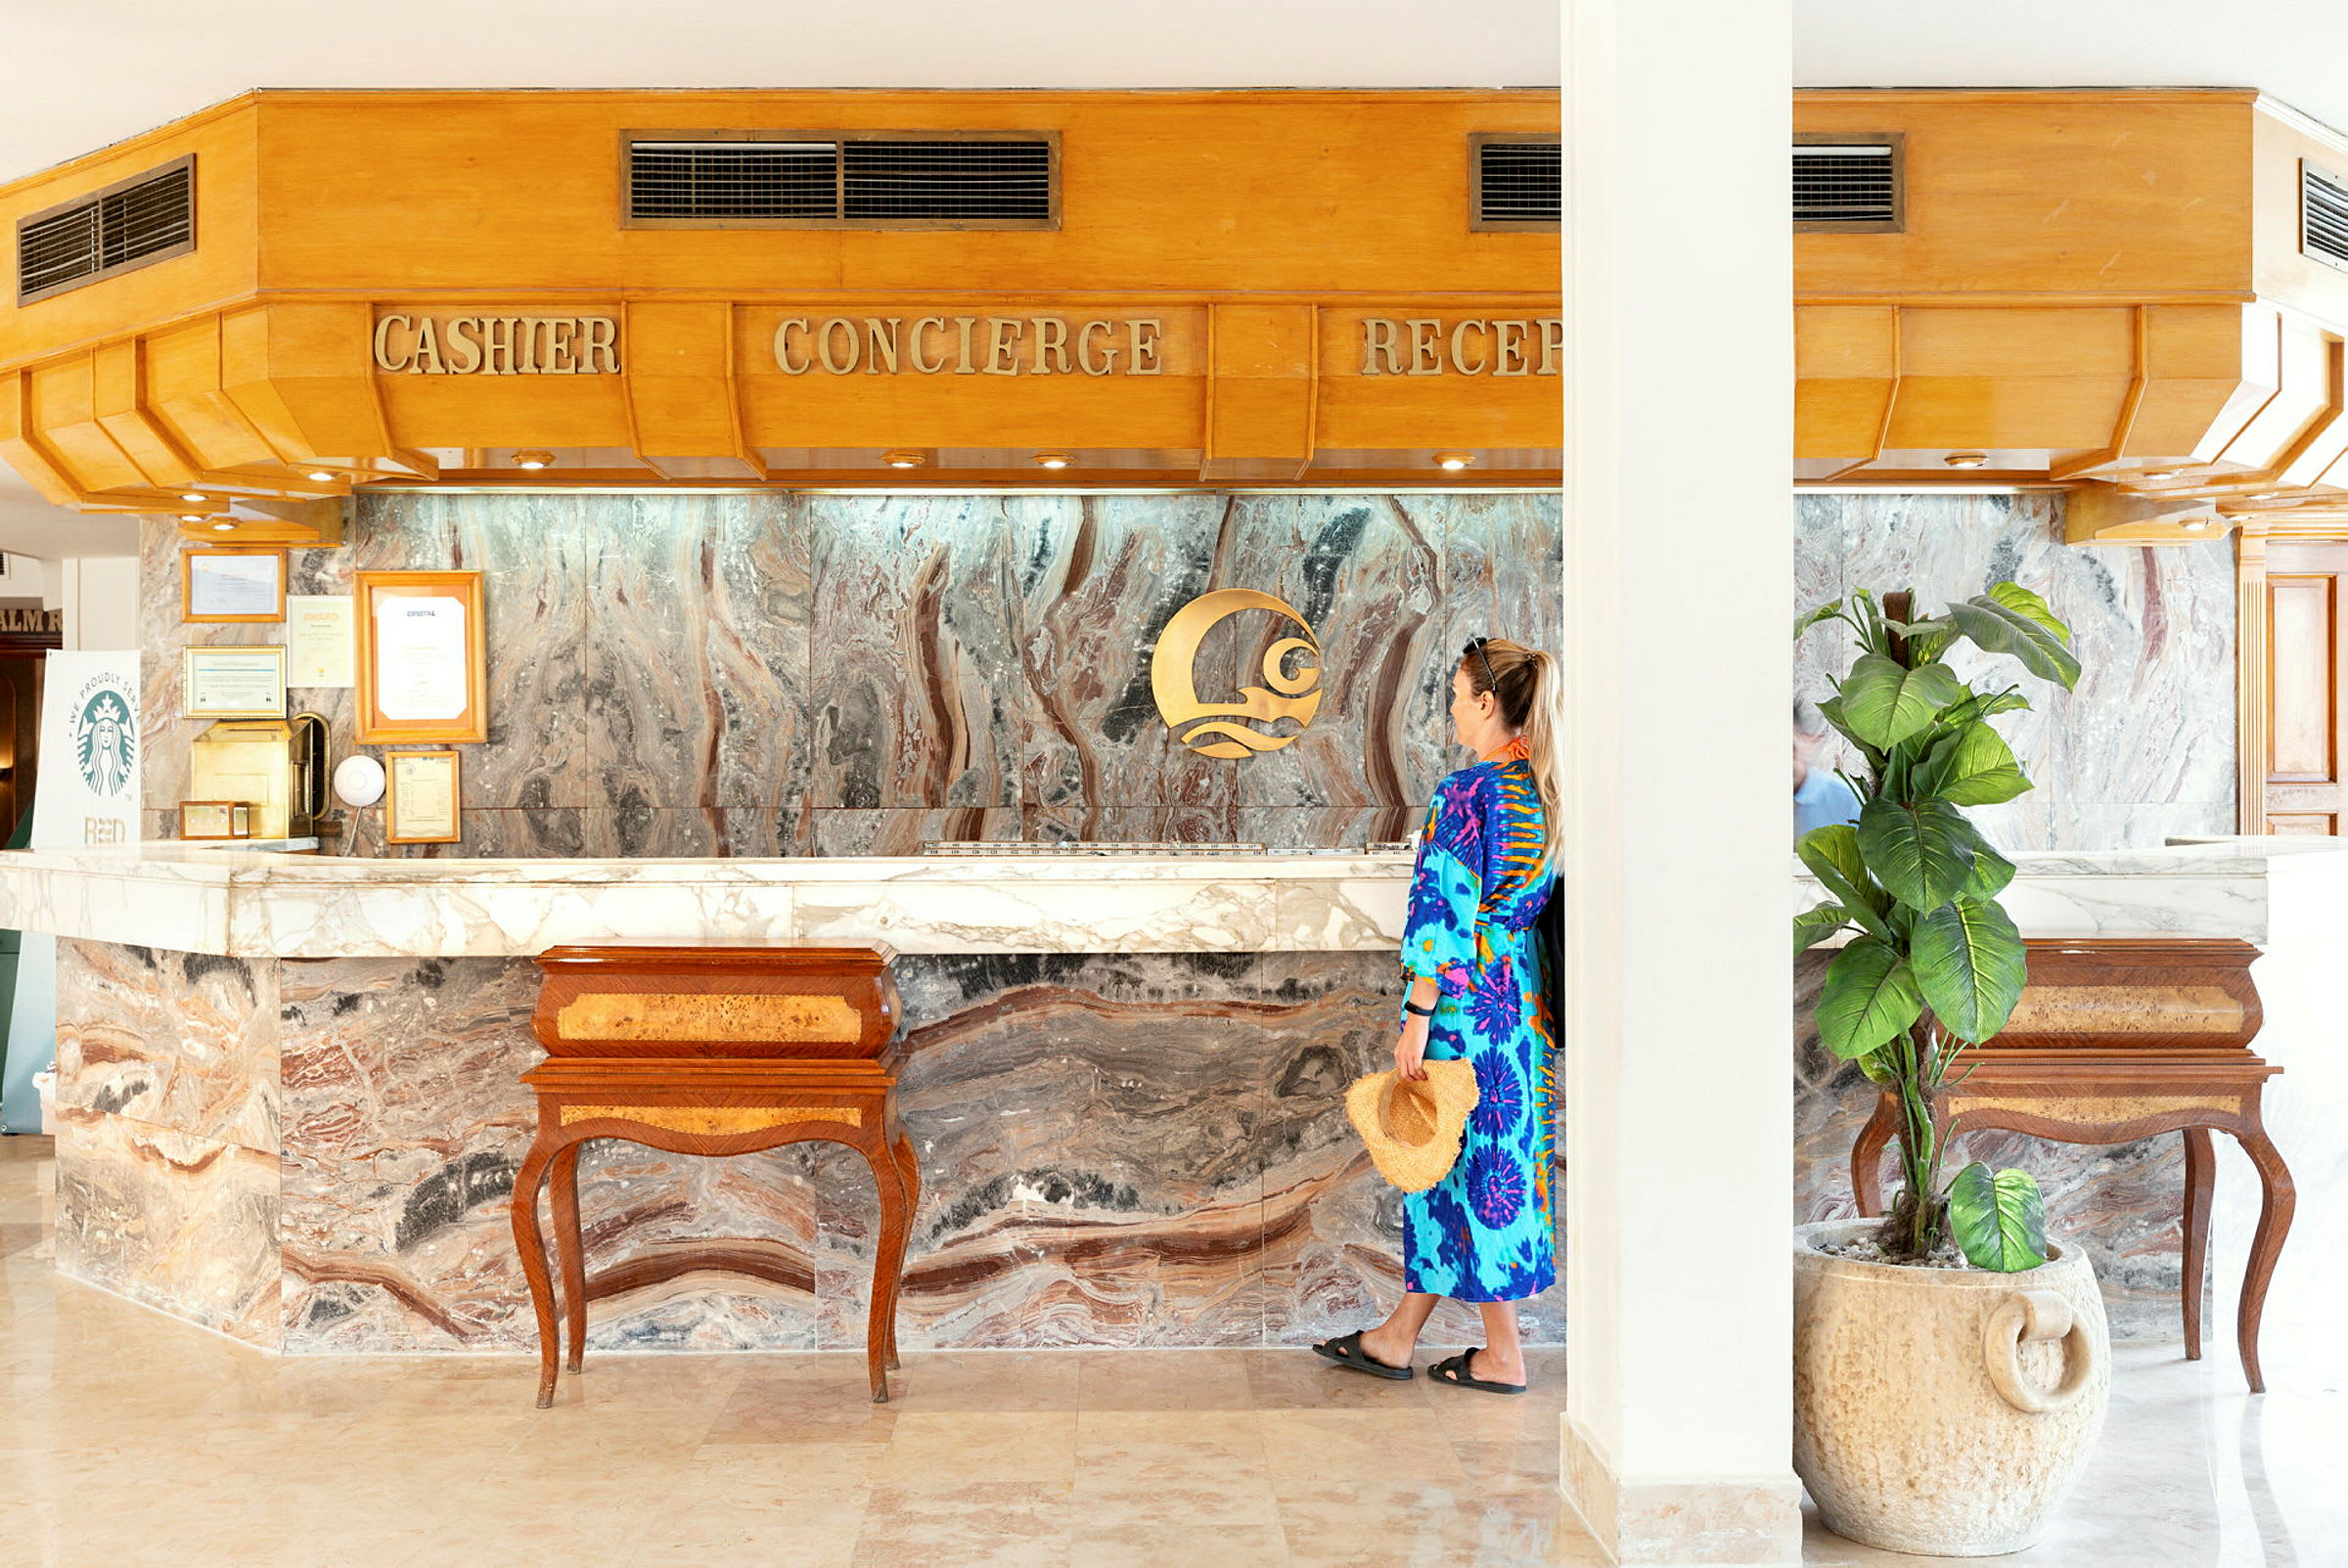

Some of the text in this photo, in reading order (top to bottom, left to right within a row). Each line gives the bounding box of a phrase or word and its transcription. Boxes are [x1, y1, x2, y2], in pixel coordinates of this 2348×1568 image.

[375, 314, 621, 376] CASHIER
[773, 316, 1163, 378] CONCIERGE
[79, 671, 121, 699] PROUDLY
